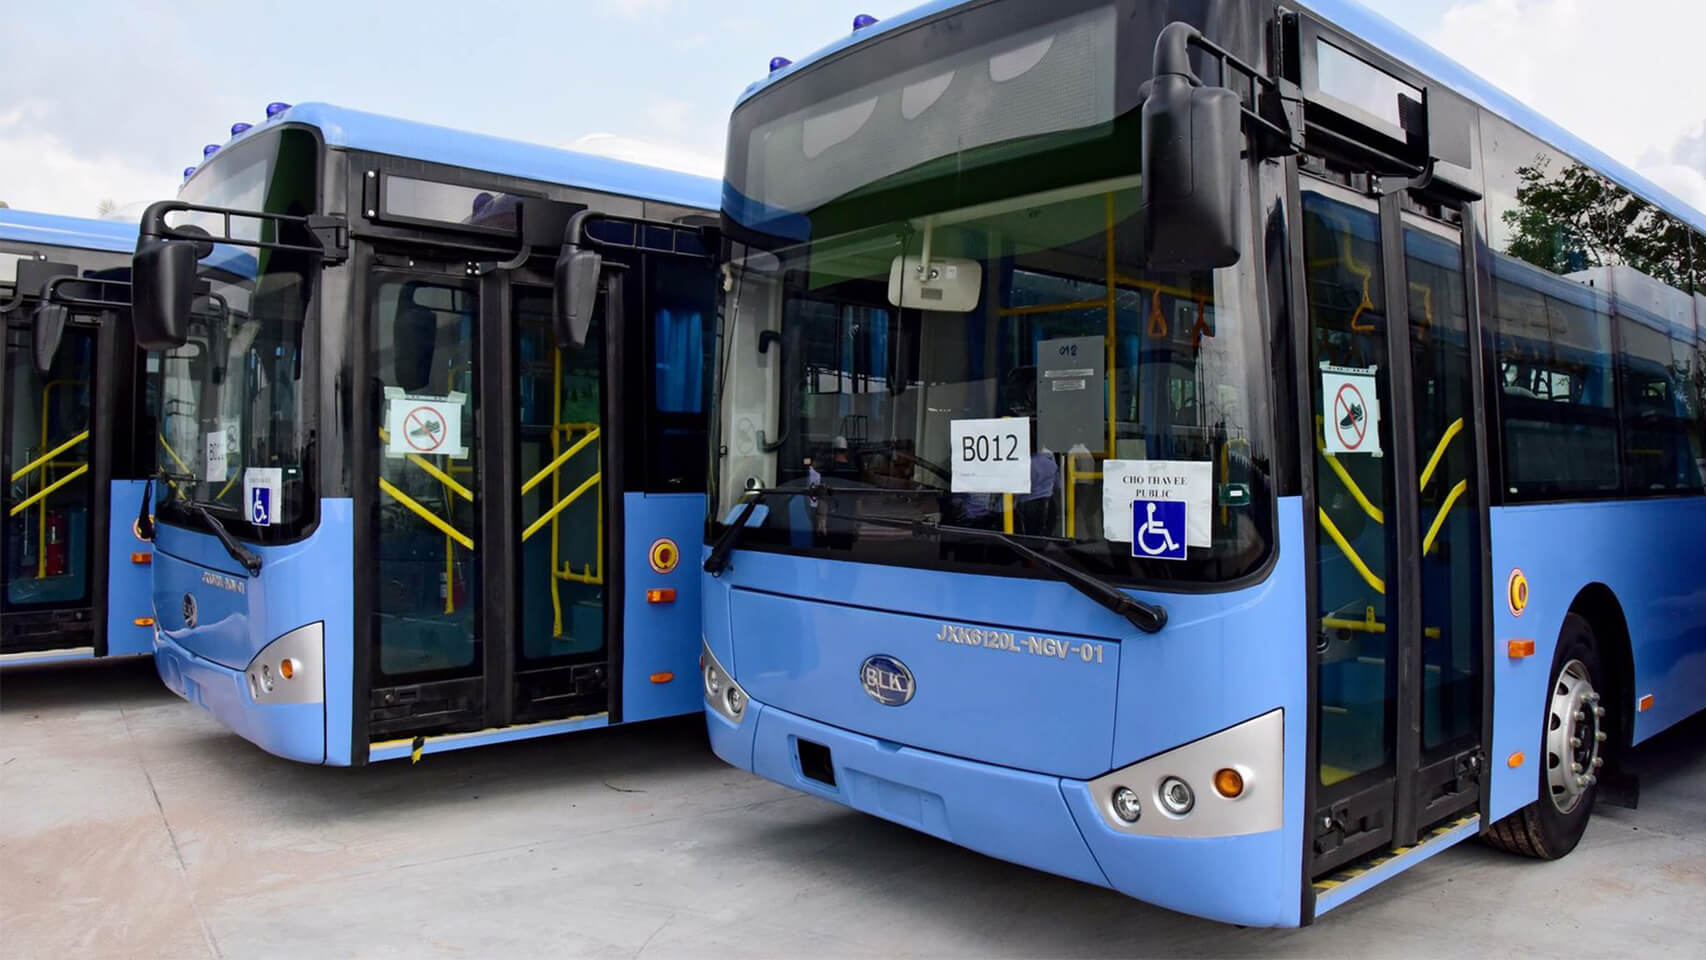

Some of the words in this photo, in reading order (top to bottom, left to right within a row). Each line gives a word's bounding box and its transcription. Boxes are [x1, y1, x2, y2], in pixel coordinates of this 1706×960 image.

[962, 433, 1019, 462] B012
[1122, 475, 1144, 484] CHO
[1147, 476, 1187, 486] THAVEE
[1136, 489, 1171, 498] PUBLIC
[936, 624, 1103, 663] JXK6120L-NGV-01
[866, 667, 906, 692] BLK
